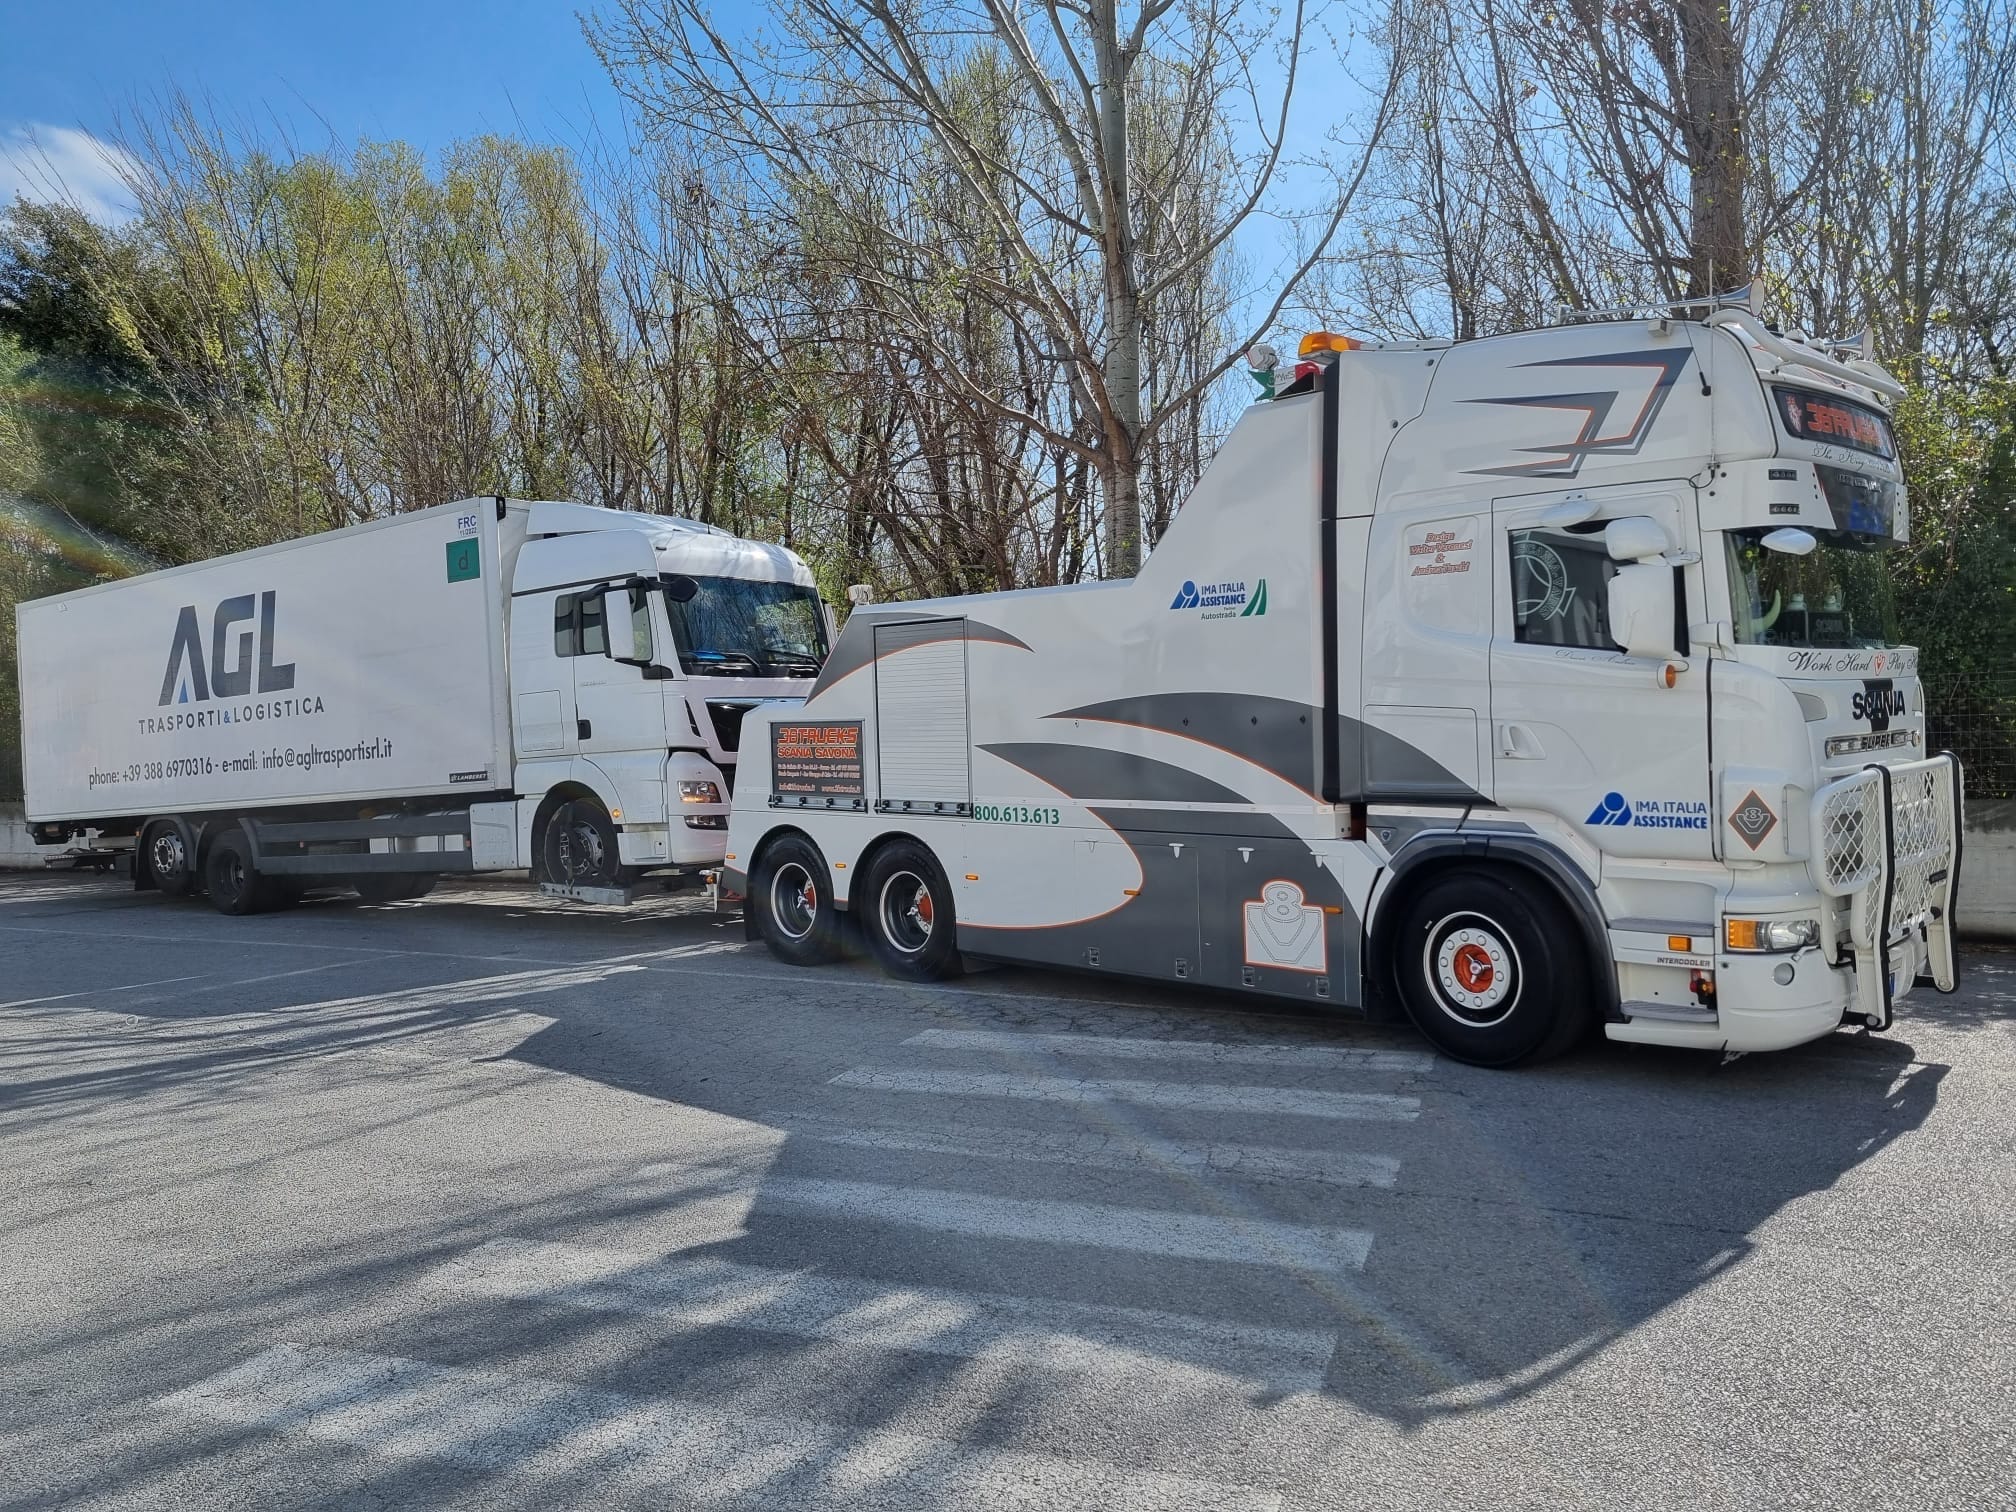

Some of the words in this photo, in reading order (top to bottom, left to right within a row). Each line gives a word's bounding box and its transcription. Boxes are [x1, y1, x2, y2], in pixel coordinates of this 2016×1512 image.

[458, 515, 477, 529] FRC
[458, 549, 469, 570] d
[1435, 553, 1445, 563] &
[1201, 585, 1217, 595] IMA
[1219, 582, 1246, 594] ITALIA
[1200, 594, 1246, 607] ASSISTANCE
[1201, 611, 1236, 620] Autostrada
[158, 590, 296, 706] AGL
[1788, 651, 1832, 672] Work
[1836, 653, 1873, 672] Hard
[1887, 652, 1905, 676] Play
[1852, 690, 1906, 720] SCANIA
[1861, 734, 1889, 751] SUPER
[777, 747, 813, 758] SCANIA
[815, 747, 857, 759] SAVONA
[89, 767, 120, 790] phone:
[123, 764, 141, 783] +39
[144, 761, 163, 780] 388
[166, 757, 212, 778] 6970316
[222, 751, 258, 772] e-mail:
[262, 737, 393, 771] info@agltrasportisrl.it
[1636, 801, 1660, 812] IMA
[1664, 802, 1707, 814] ITALIA
[974, 805, 1060, 825] 800.613.613
[1633, 815, 1708, 829] ASSISTANCE
[1657, 956, 1711, 968] INTERCOOLER
